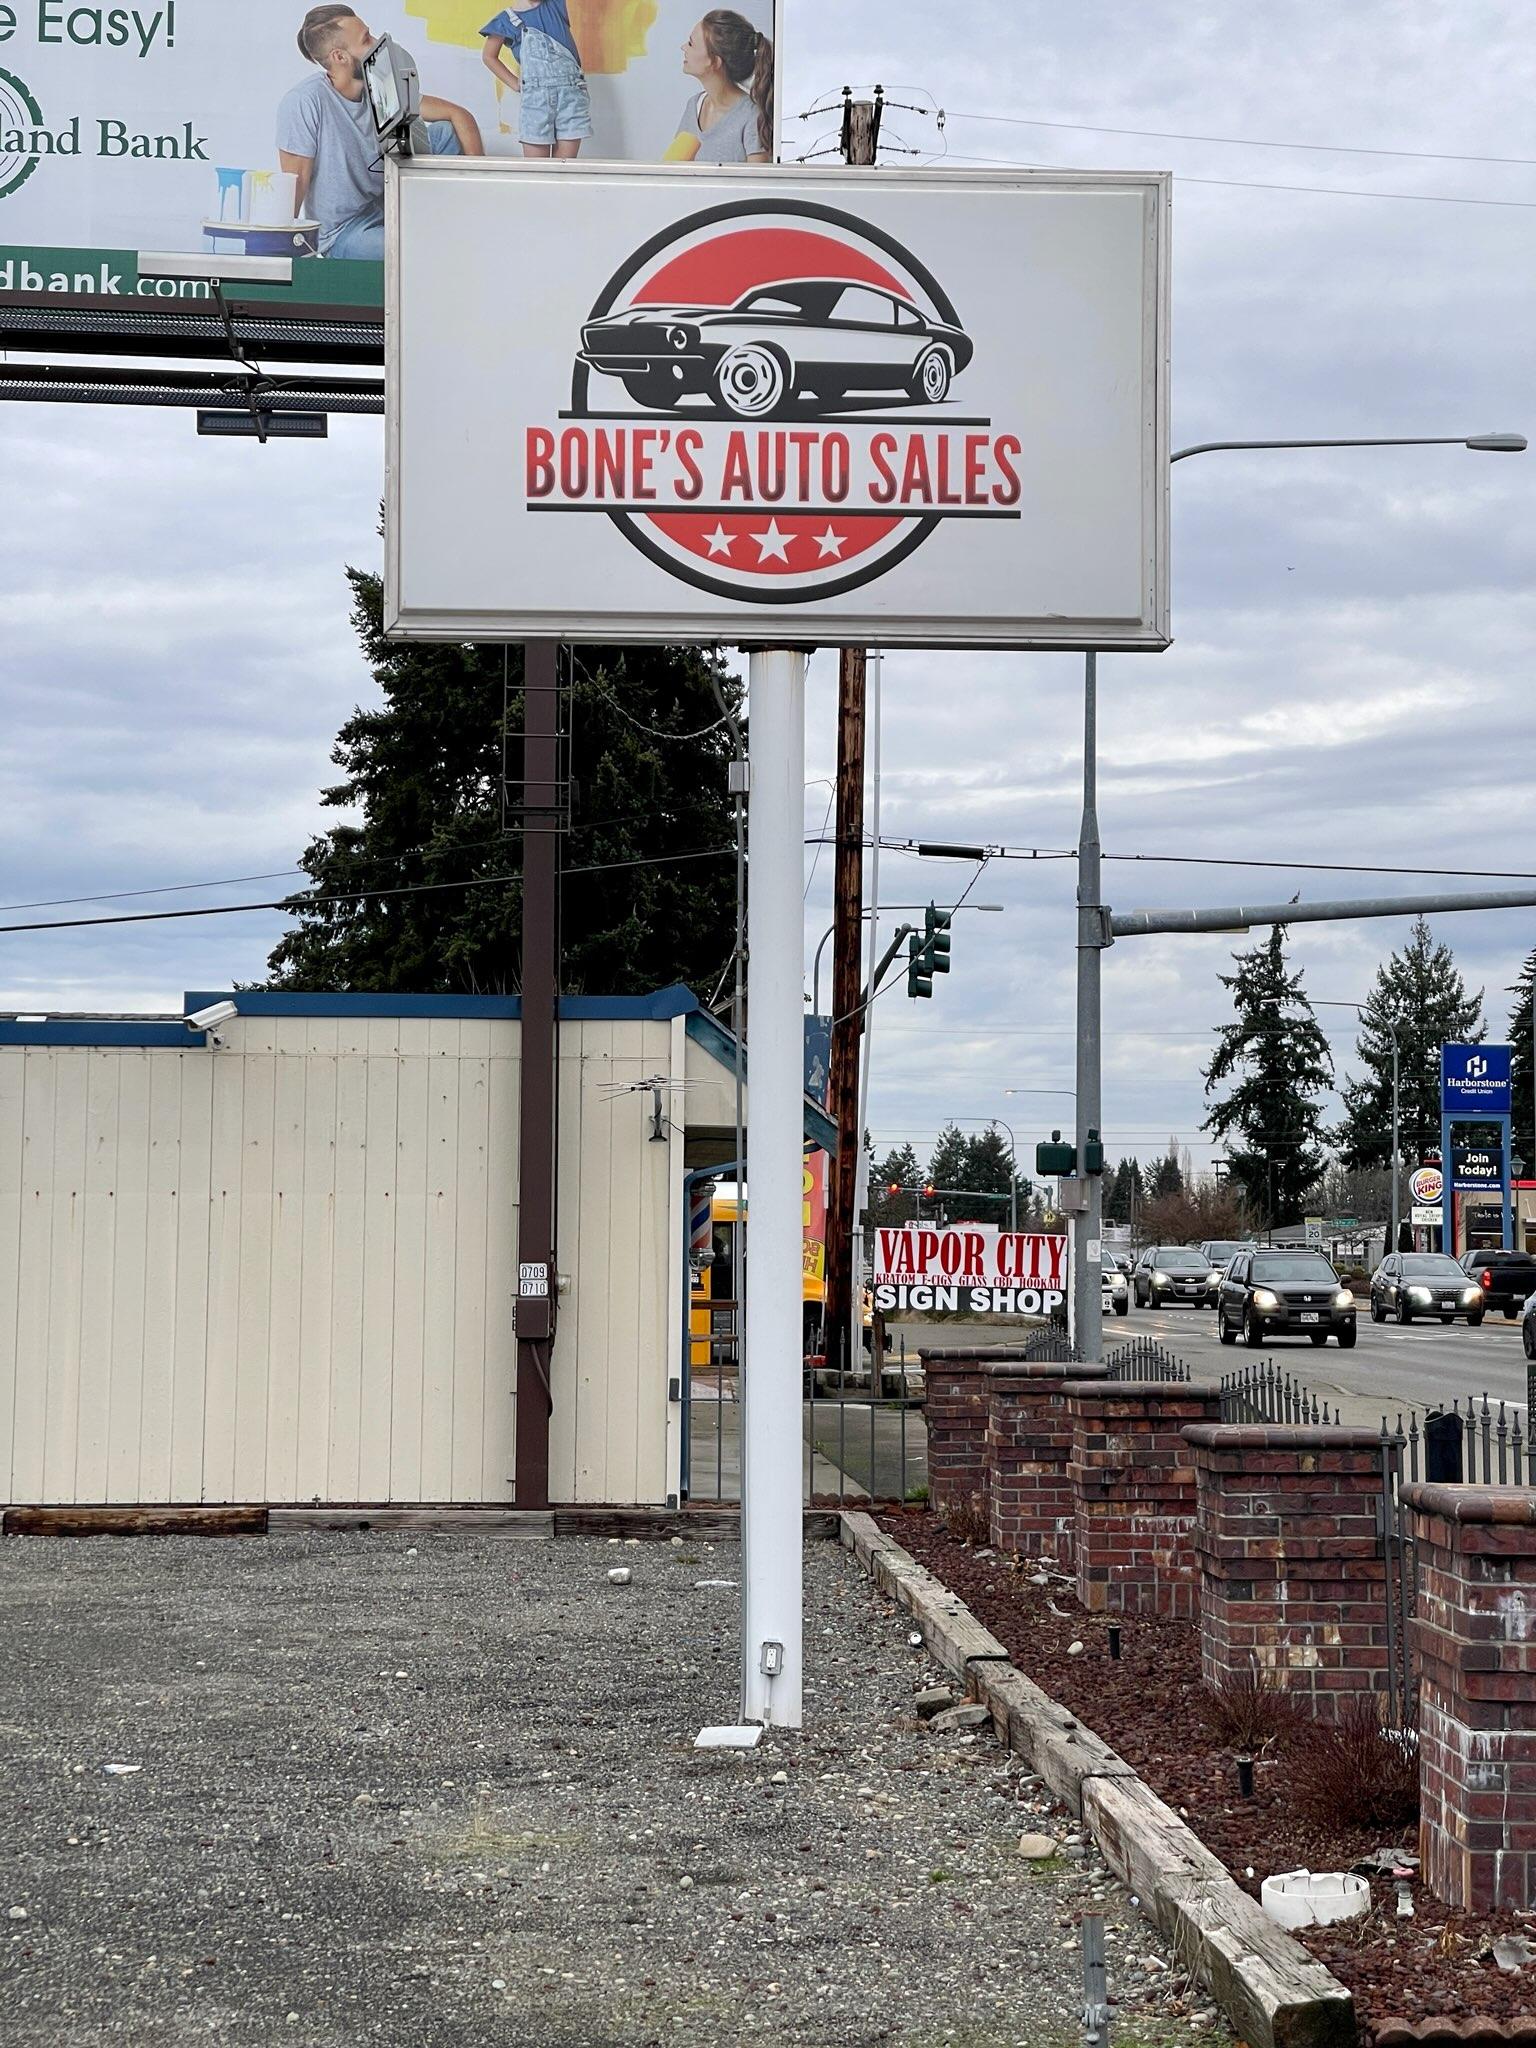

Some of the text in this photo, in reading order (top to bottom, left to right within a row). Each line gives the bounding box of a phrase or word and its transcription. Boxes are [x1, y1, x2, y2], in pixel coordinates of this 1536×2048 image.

[39, 0, 175, 58] Easy!
[0, 113, 210, 160] and Bank
[526, 427, 1022, 506] BONE'S AUTO SALES
[1447, 1078, 1507, 1088] Harborstone
[1466, 1153, 1489, 1163] Join
[1458, 1165, 1497, 1177] Today!
[1416, 1175, 1441, 1187] BURGER
[1417, 1181, 1442, 1195] KING
[1308, 1230, 1320, 1238] 20
[879, 1229, 1067, 1279] VAPOR CITY
[875, 1272, 1061, 1290] KRATOM E-CIGS GLASS CBD HOOKAH
[875, 1285, 1063, 1314] SIGN SHOP
